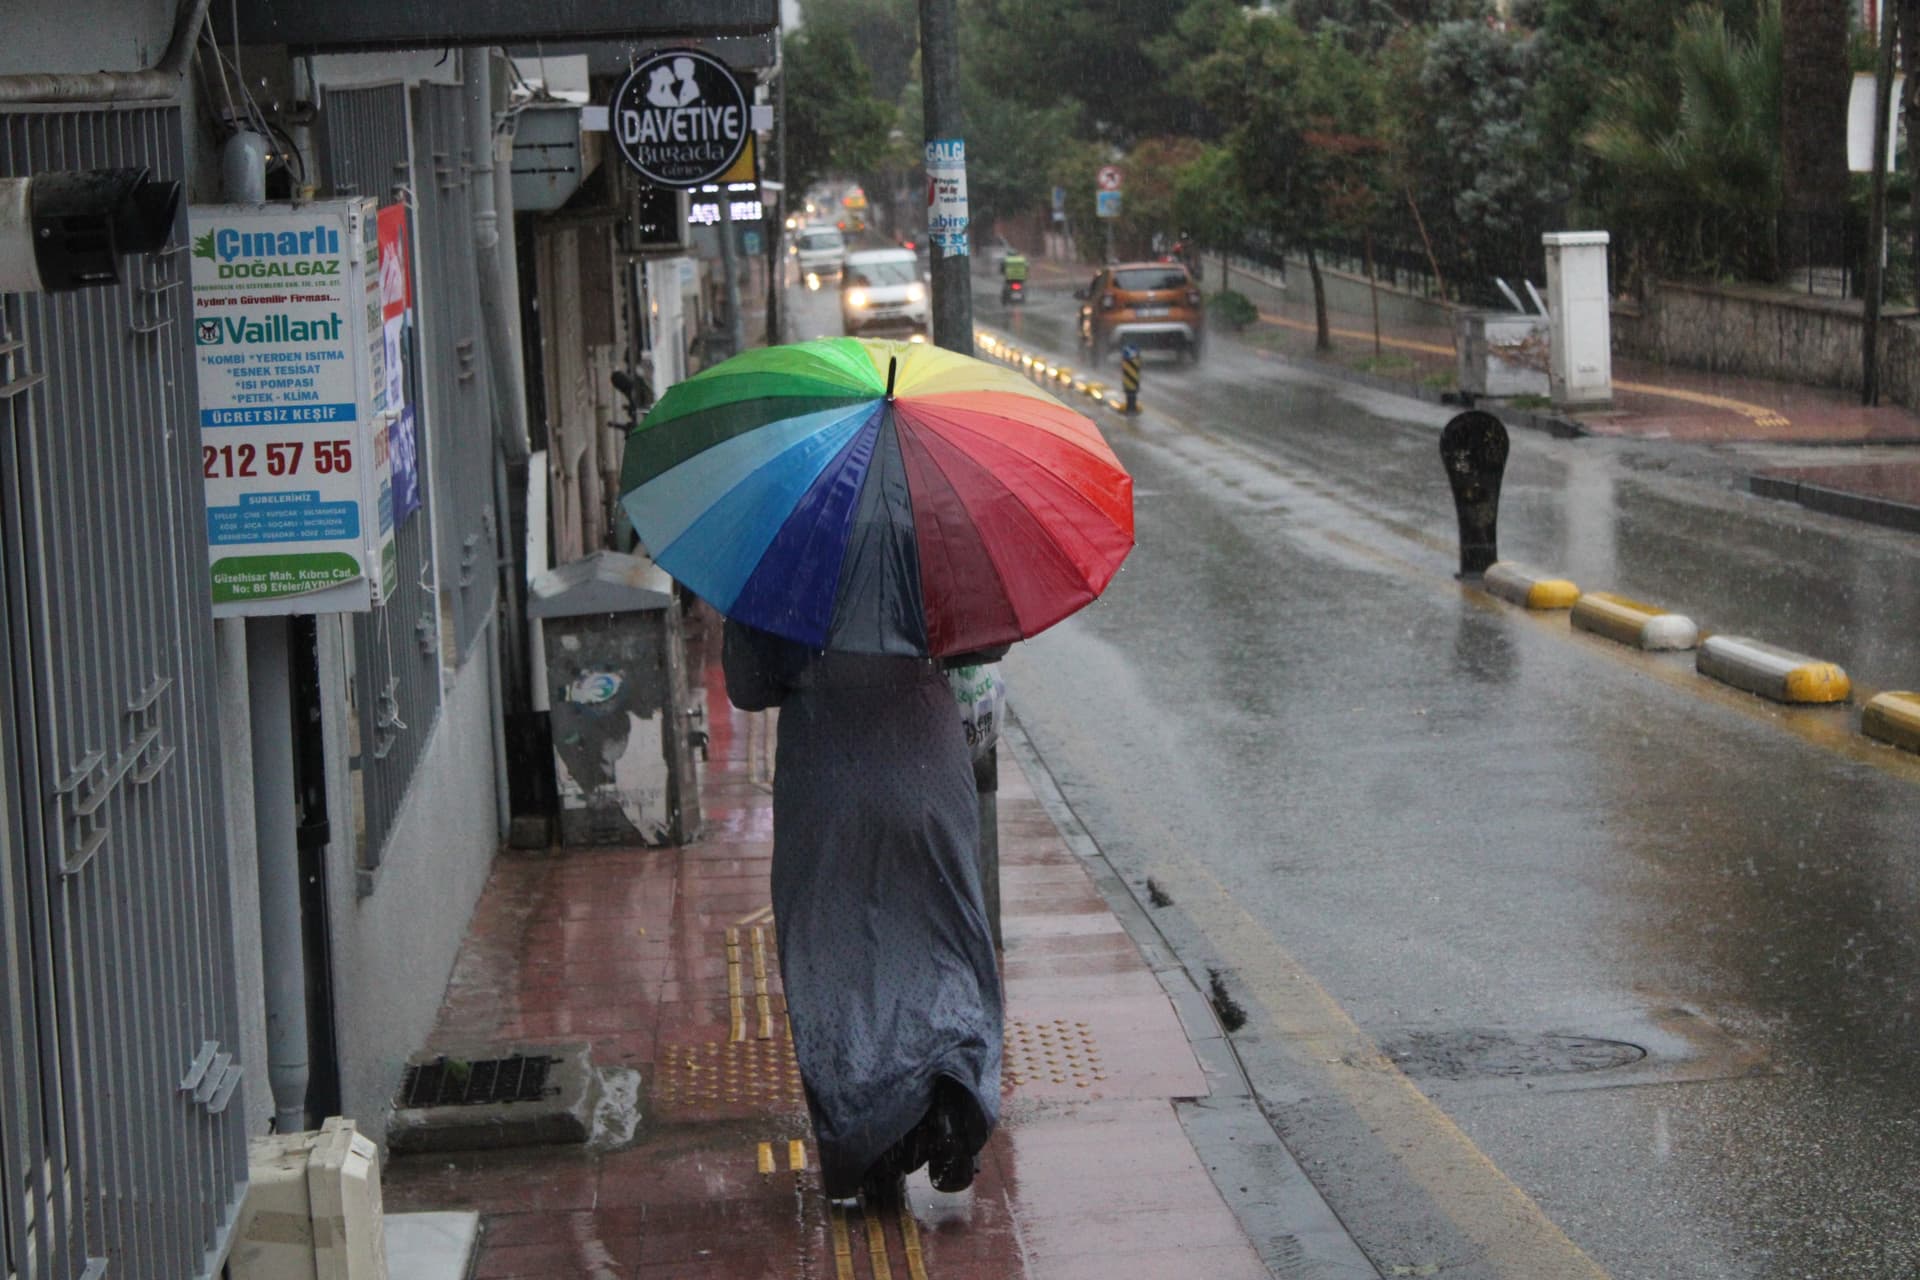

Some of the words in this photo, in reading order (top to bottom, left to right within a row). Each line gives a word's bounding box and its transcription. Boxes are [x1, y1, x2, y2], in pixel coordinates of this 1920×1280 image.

[623, 100, 739, 144] DAVETİYE
[217, 225, 340, 263] Çınarlı
[218, 259, 340, 279] DOĞALGAZ
[240, 293, 288, 305] Güvenilir
[225, 312, 343, 345] Vaillant
[207, 352, 245, 365] KOMBİ
[256, 352, 302, 363] YERDEN
[233, 367, 271, 377] ESNEK
[274, 364, 321, 375] TESİSAT
[241, 379, 257, 390] ISI
[260, 378, 314, 389] POMPASI
[237, 392, 273, 404] PETEK
[283, 390, 320, 402] KLİMA
[212, 408, 289, 424] ÜCRETSİZ
[293, 407, 337, 422] KEŞİF
[203, 443, 257, 478] 212
[266, 442, 304, 476] 57
[314, 440, 352, 475] 55
[214, 571, 267, 584] Güzelhisar
[269, 570, 296, 582] Mah.
[232, 585, 250, 594] No:
[253, 583, 267, 593] 89
